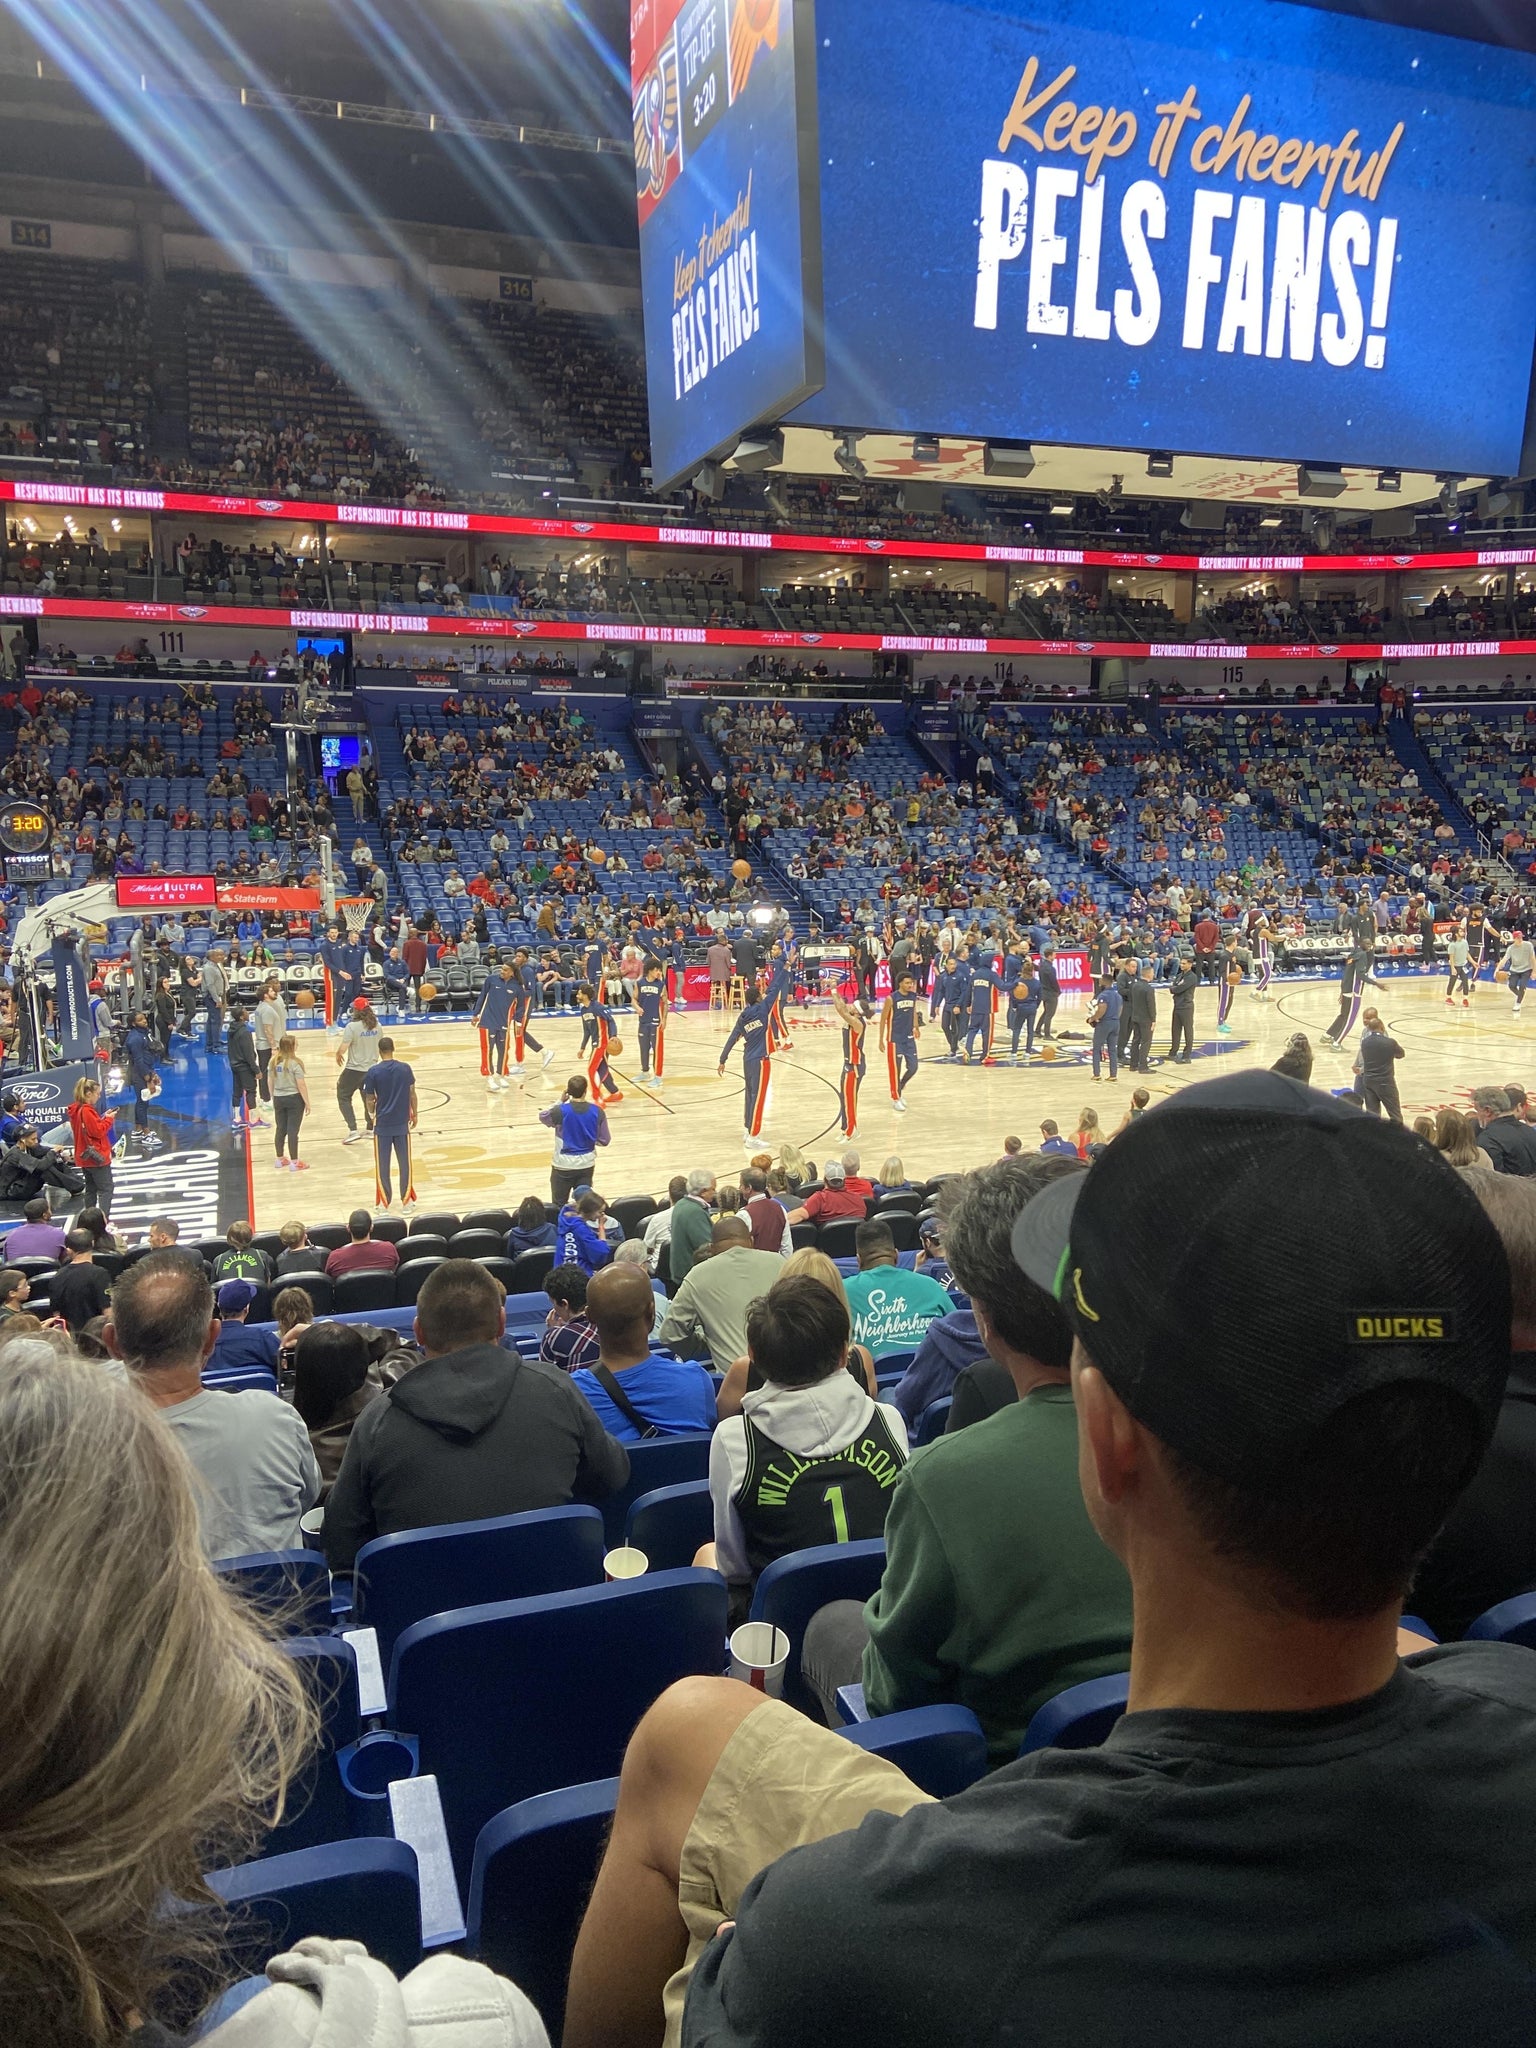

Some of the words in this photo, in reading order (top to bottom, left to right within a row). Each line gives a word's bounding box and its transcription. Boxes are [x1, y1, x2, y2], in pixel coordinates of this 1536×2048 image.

[683, 6, 717, 88] TIP-OFF
[693, 72, 716, 128] 3:20
[998, 56, 1138, 183] Keep
[1149, 84, 1200, 179] it
[1192, 93, 1405, 208] cheerful
[17, 224, 48, 243] 314
[674, 248, 696, 310] Keep
[698, 222, 709, 281] it
[706, 167, 752, 269] cheerful
[974, 159, 1166, 348] PELS
[1182, 187, 1399, 370] FANS!
[504, 280, 530, 297] 316
[672, 285, 709, 400] PELS
[708, 229, 760, 370] FANS!
[14, 482, 84, 502] RESPONSIBILITY
[87, 487, 106, 504] HAS
[107, 489, 122, 506] ITS
[124, 490, 164, 508] REWARDS
[338, 505, 400, 525] RESPONSIBILITY
[402, 510, 417, 526] HAS
[419, 511, 432, 527] ITS
[434, 512, 469, 529] REWARDS
[658, 528, 713, 544] RESPONSIBILITY
[714, 531, 728, 545] HAS
[728, 532, 740, 546] ITS
[741, 532, 772, 548] REWARDS
[290, 611, 357, 628] RESPONSIBILITY
[358, 615, 374, 629] HAS
[376, 616, 390, 630] ITS
[391, 616, 429, 632] REWARDS
[159, 631, 184, 653] 111
[586, 624, 642, 641] RESPONSIBILITY
[644, 627, 659, 642] HAS
[660, 628, 672, 642] ITS
[674, 628, 706, 643] REWARDS
[470, 644, 495, 662] 112
[882, 636, 932, 650] RESPONSIBILITY
[934, 638, 946, 651] HAS
[947, 638, 958, 651] ITS
[958, 638, 988, 652] REWARDS
[1150, 644, 1196, 658] RESPONSIBILITY
[1196, 645, 1208, 658] HAS
[1208, 646, 1218, 658] ITS
[1218, 646, 1248, 659] REWARDS
[1382, 644, 1436, 657] RESPONSIBILITY
[1436, 643, 1452, 656] HAS
[1452, 642, 1464, 656] ITS
[1466, 642, 1500, 656] REWARDS
[994, 662, 1014, 680] 114
[1222, 666, 1243, 684] 115
[488, 678, 512, 687] PELICANS
[513, 679, 528, 687] RADIO
[13, 816, 42, 830] 3:20
[171, 884, 204, 892] ULTRA
[12, 1084, 50, 1100] Ford
[35, 1106, 68, 1116] QUALIT
[236, 1264, 243, 1278] 1
[867, 1289, 908, 1323] Sixth
[1356, 1318, 1444, 1338] DUCKS
[824, 1486, 849, 1544] 1
